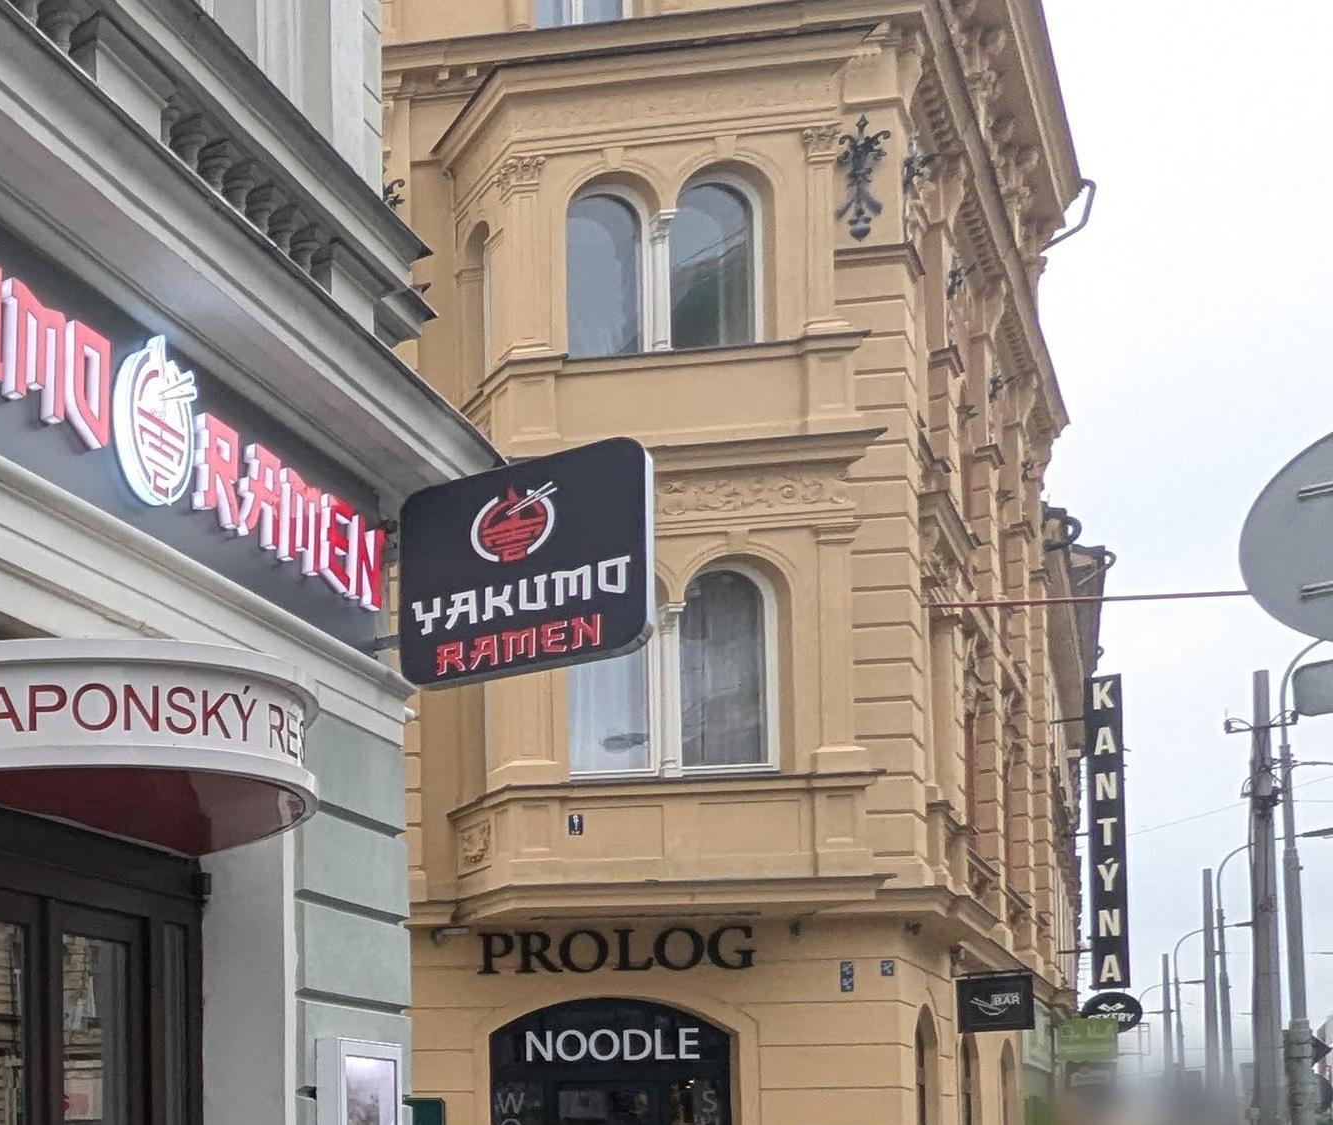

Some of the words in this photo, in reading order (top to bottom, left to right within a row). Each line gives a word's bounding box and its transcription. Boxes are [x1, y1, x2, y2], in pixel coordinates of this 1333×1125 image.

[190, 411, 384, 612] RAMEN
[411, 555, 631, 636] YAKUMO
[435, 613, 603, 677] RAMEN
[1092, 680, 1122, 983] KANTÝNA
[477, 924, 757, 976] PROLOG
[525, 1027, 701, 1063] NOODLE
